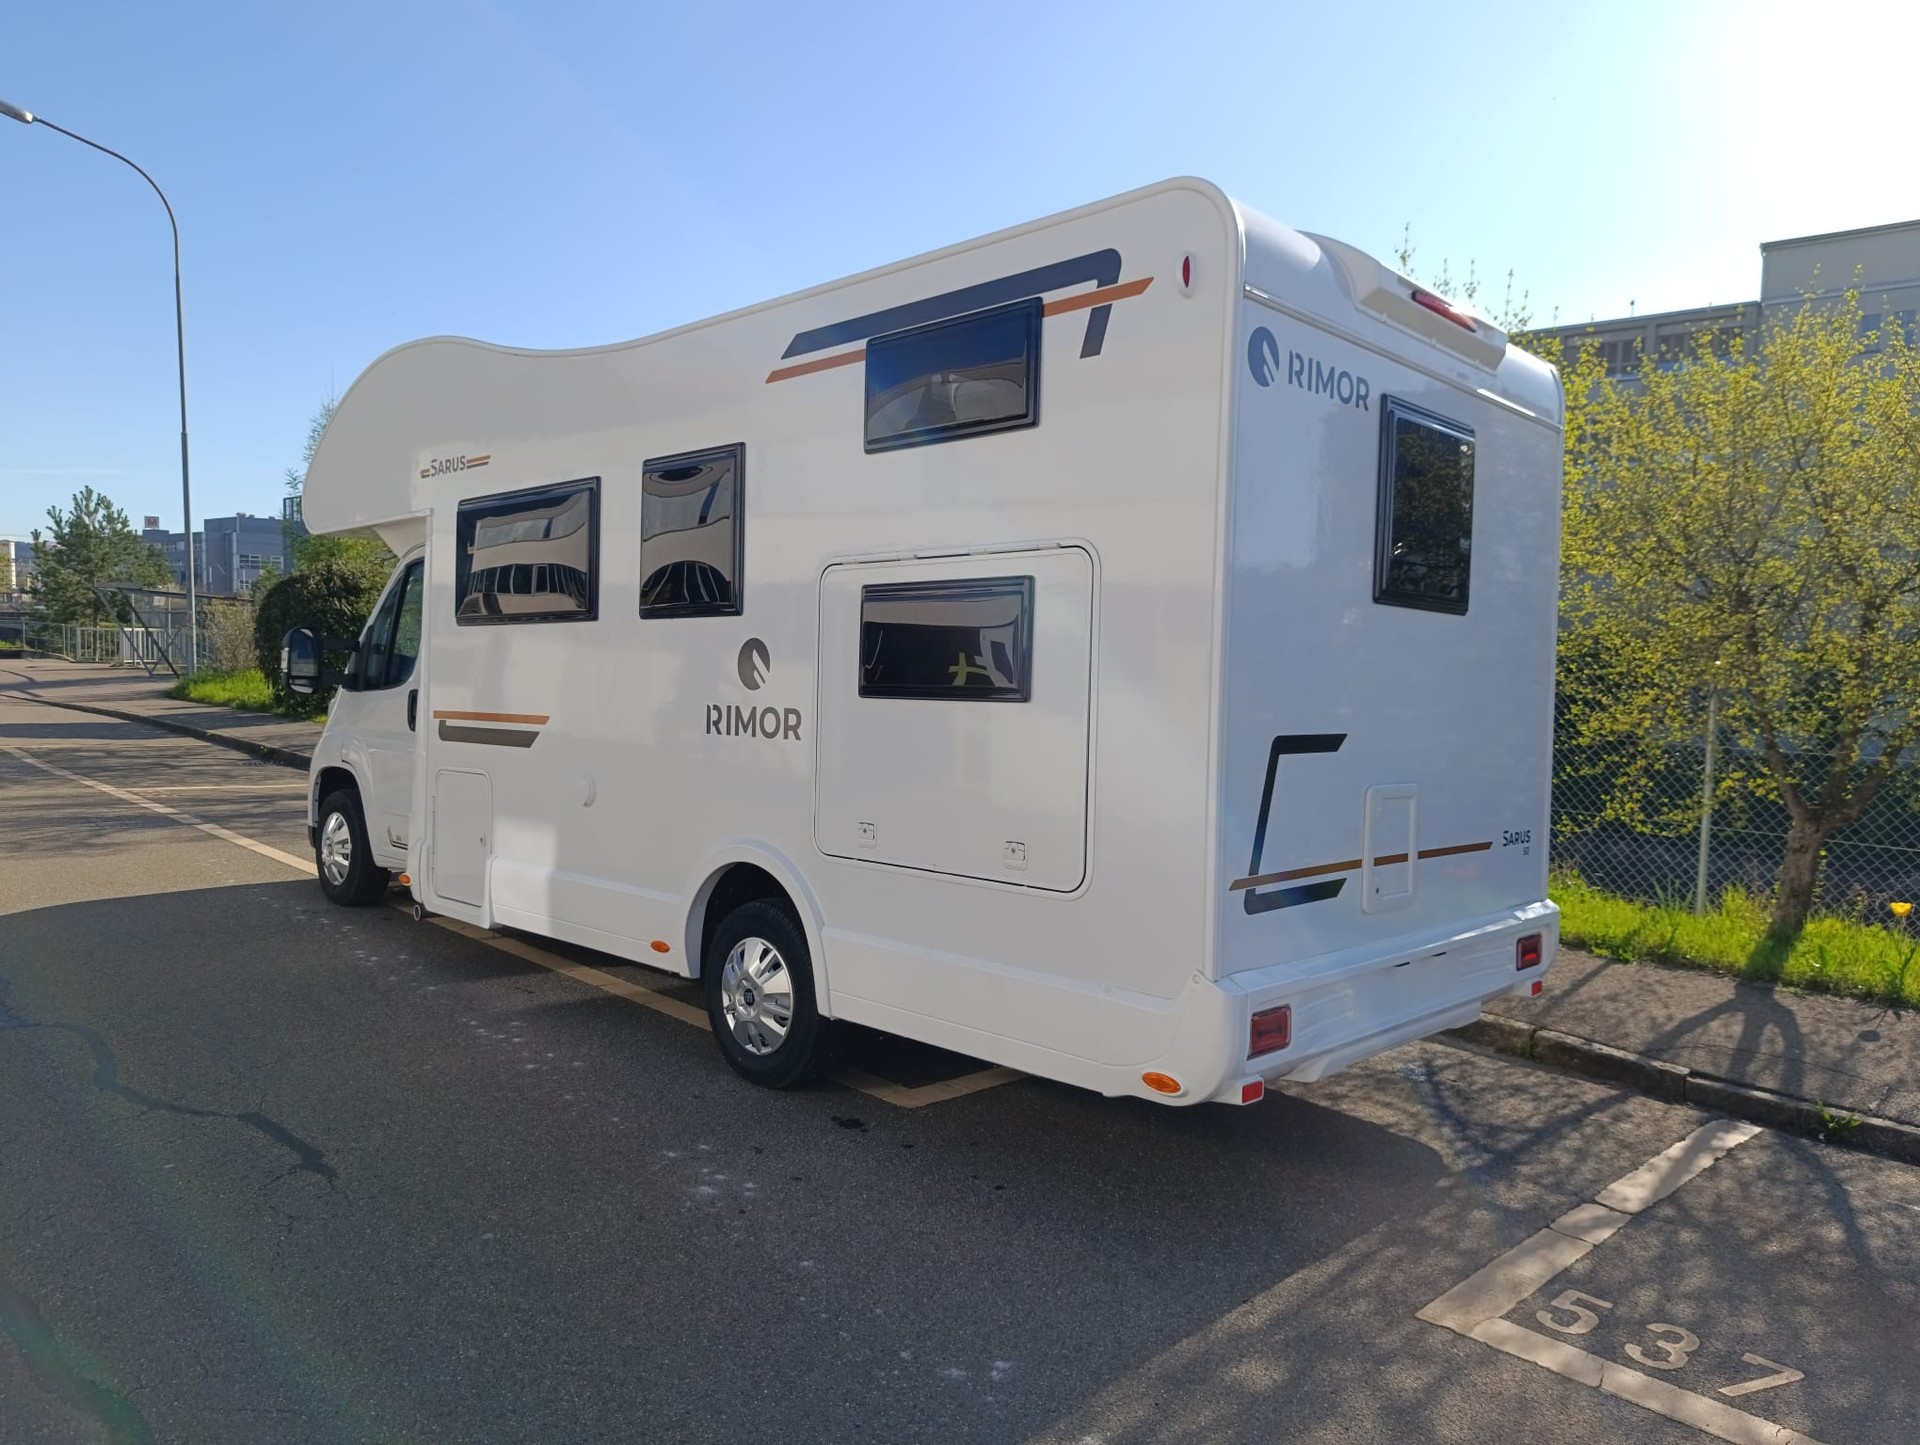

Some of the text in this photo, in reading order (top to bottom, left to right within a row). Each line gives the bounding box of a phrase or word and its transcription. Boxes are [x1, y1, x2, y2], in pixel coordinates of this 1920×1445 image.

[1288, 350, 1369, 412] RIMOR
[430, 455, 466, 477] SARUS
[706, 704, 802, 741] RIMOR
[1502, 830, 1531, 846] SARUS
